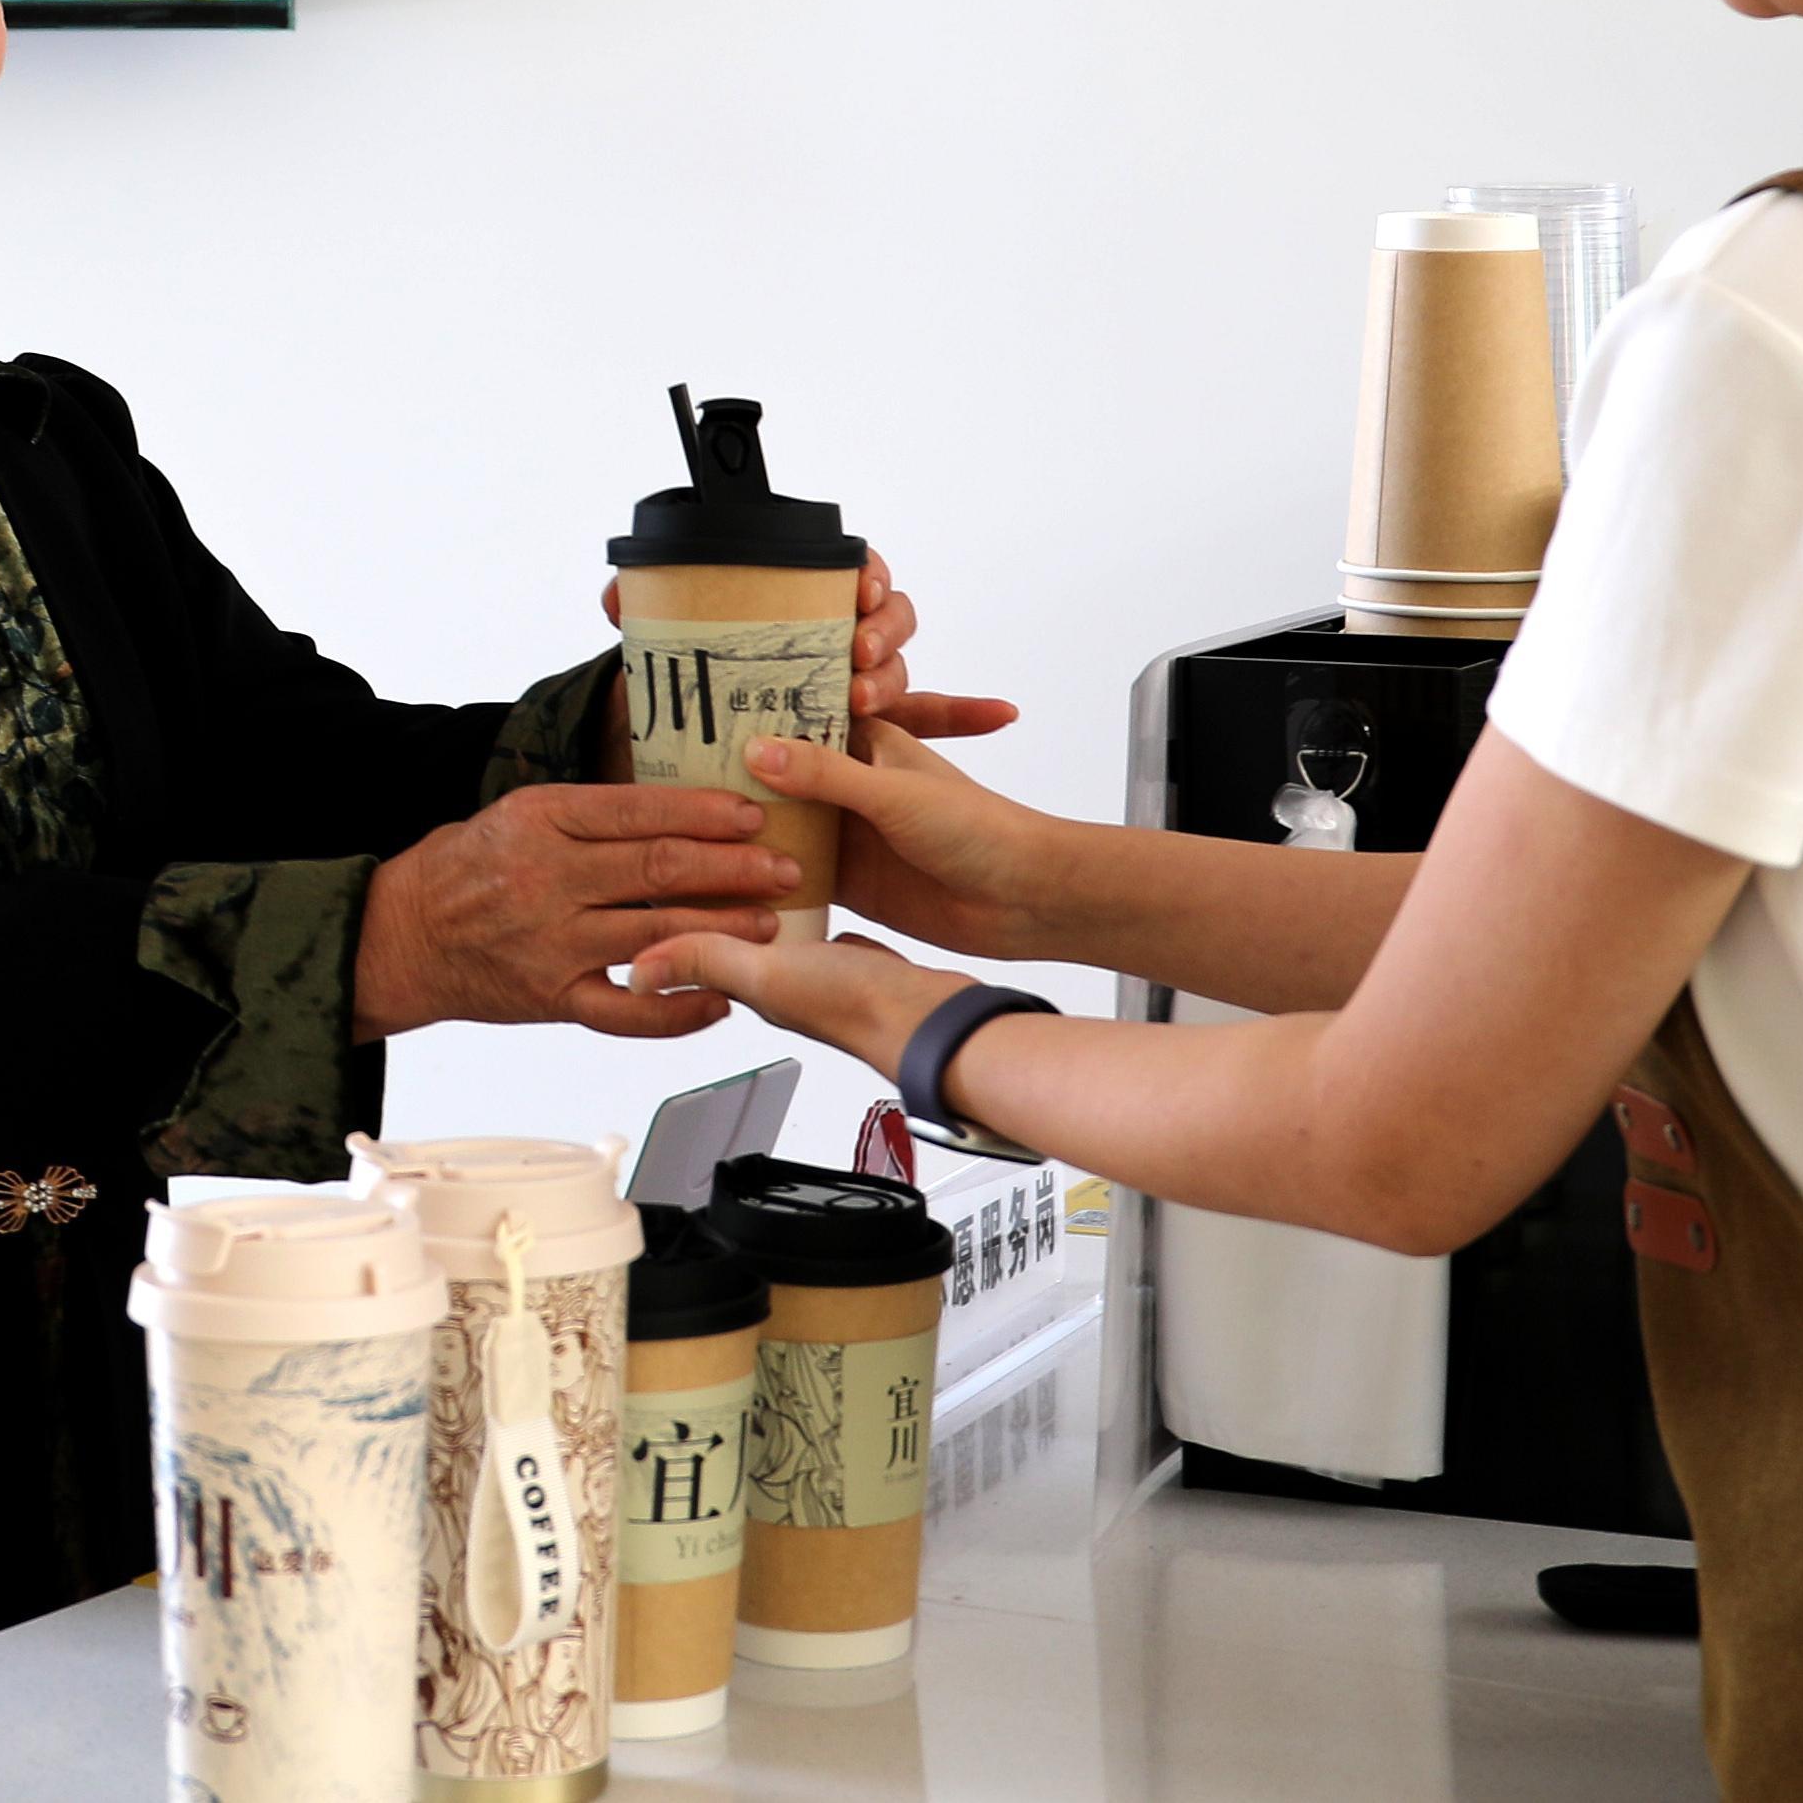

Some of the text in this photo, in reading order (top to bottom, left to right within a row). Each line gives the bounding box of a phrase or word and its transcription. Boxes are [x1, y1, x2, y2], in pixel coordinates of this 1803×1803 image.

[943, 1169, 1056, 1308] 愿服务岗
[885, 1375, 920, 1469] 宜川
[515, 1454, 560, 1621] COFFEE
